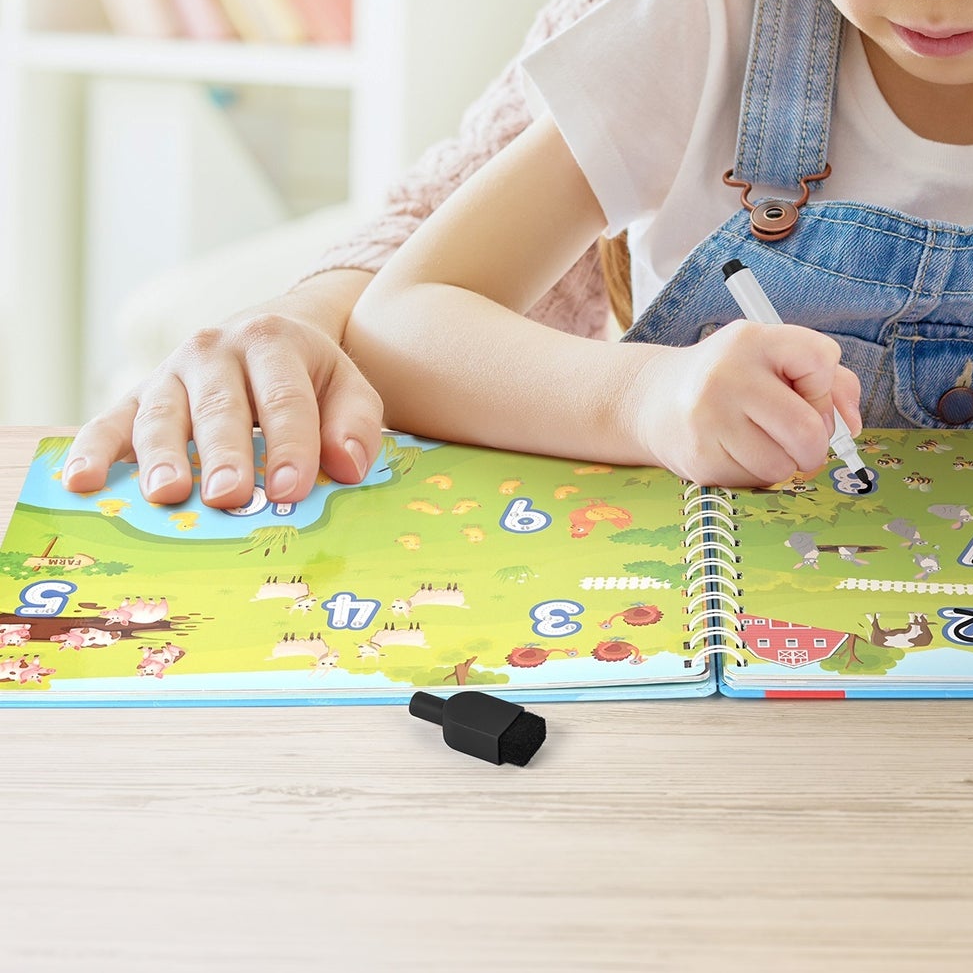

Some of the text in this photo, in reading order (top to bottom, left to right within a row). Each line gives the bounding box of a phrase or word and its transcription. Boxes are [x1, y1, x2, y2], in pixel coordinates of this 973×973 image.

[48, 558, 82, 566] FARM
[14, 579, 78, 617] 5
[321, 592, 381, 631] 4
[529, 599, 585, 638] 3
